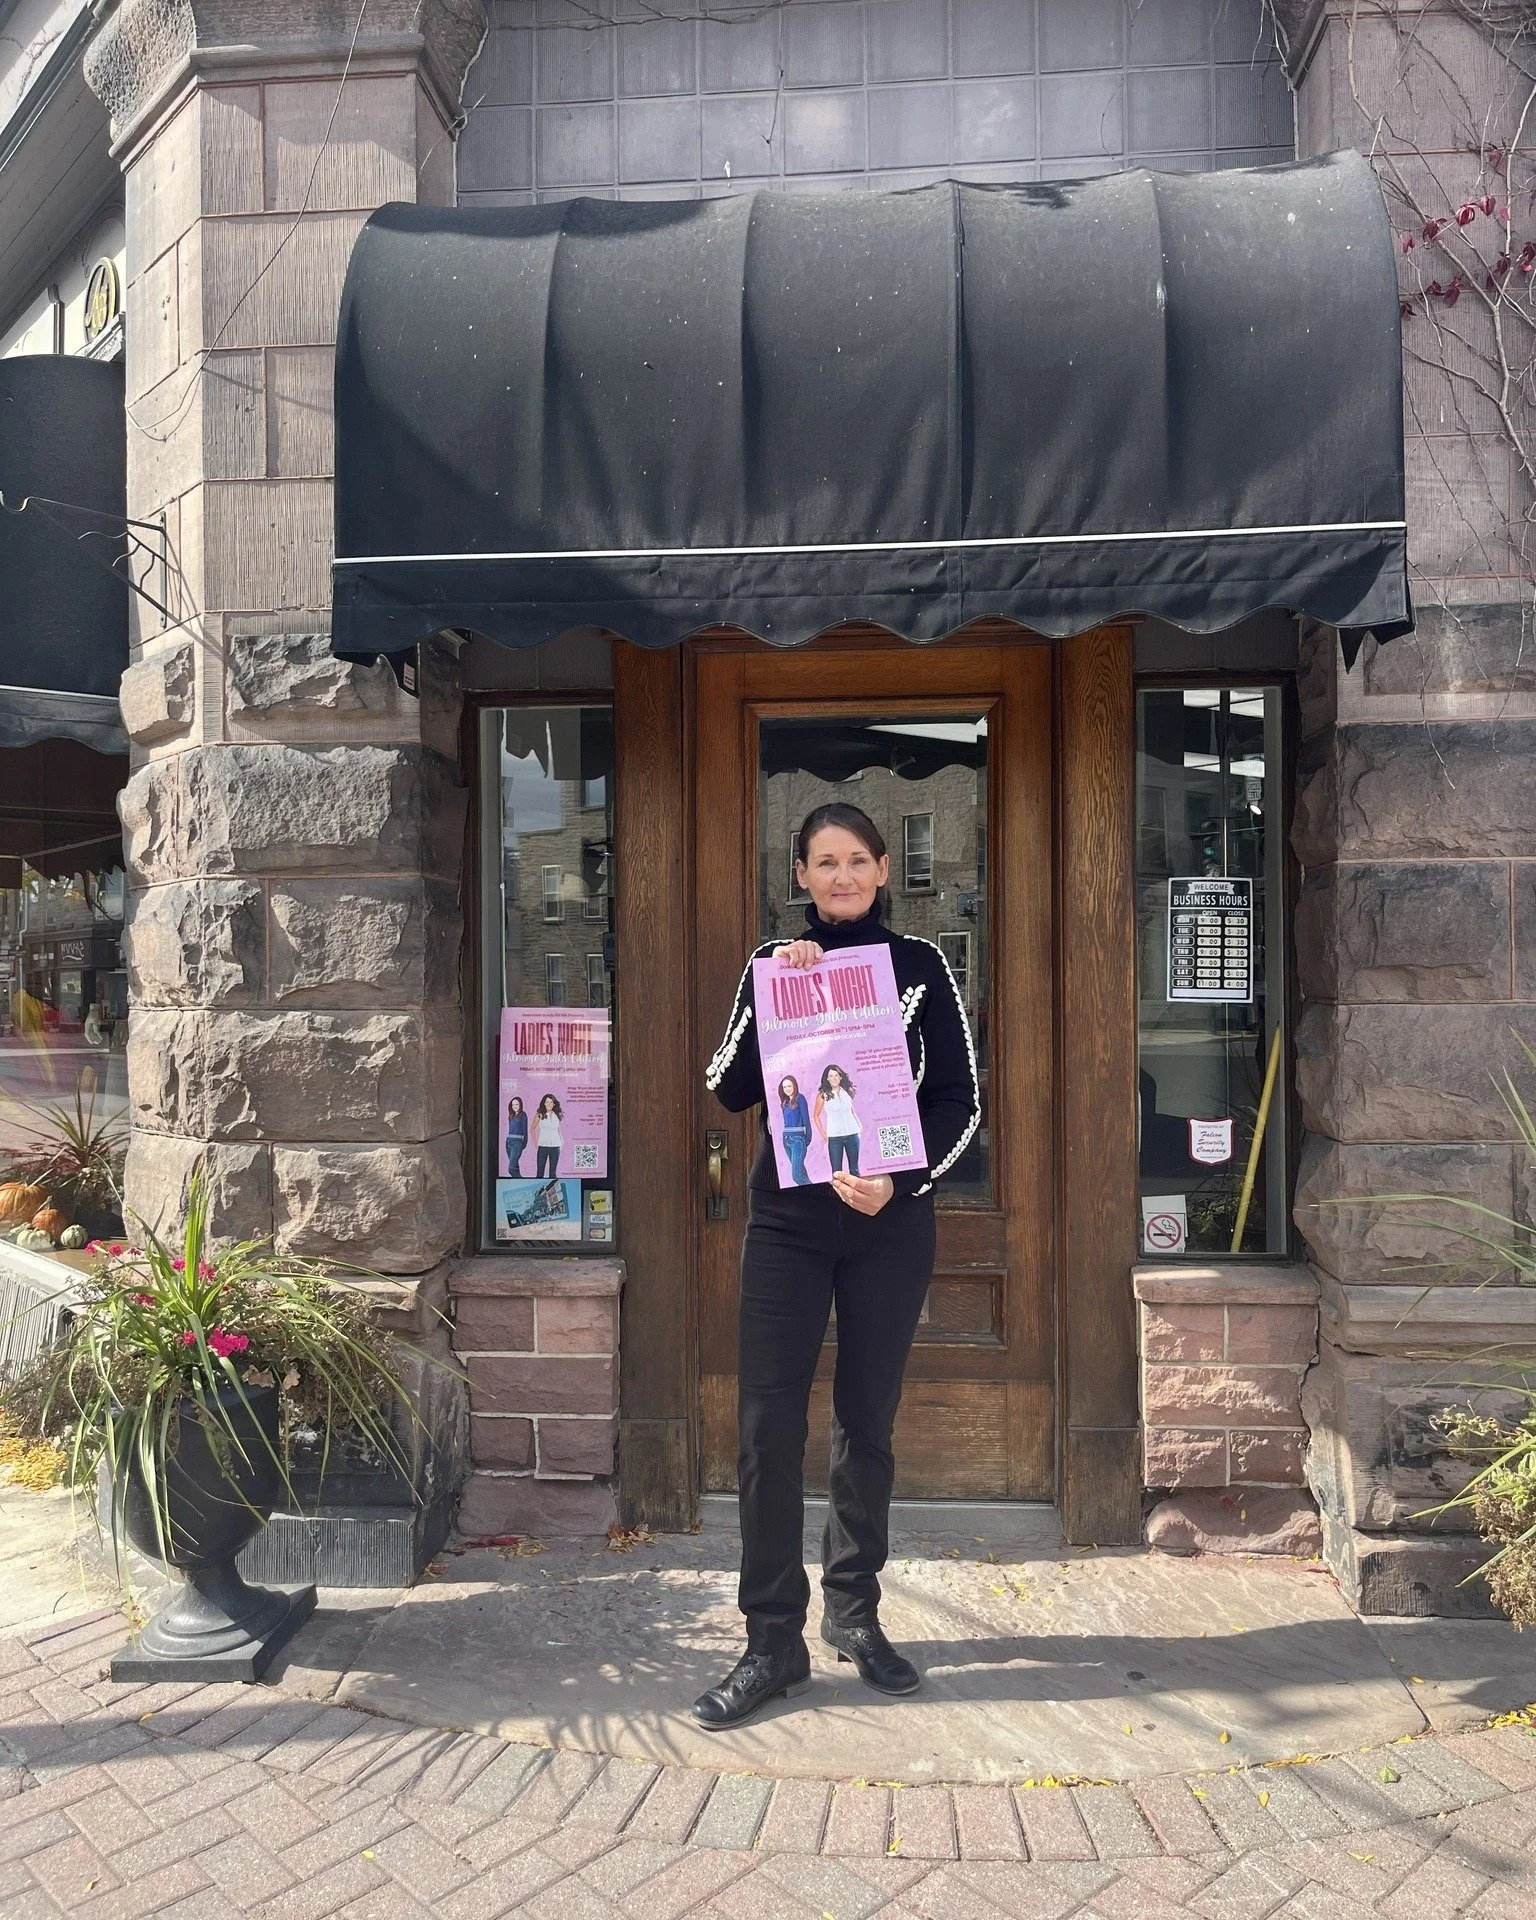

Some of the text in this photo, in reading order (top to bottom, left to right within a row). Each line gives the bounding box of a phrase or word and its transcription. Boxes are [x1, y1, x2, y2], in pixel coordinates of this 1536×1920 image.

[1173, 895, 1248, 906] BUSINESS HOURS
[771, 964, 878, 1022] LADIES NIGHT
[761, 1003, 896, 1034] Gilmore Girls Edition
[514, 1022, 593, 1056] LADIES NIGHT
[808, 1029, 835, 1038] OCTOBER
[503, 1051, 540, 1063] Gilmore
[544, 1051, 567, 1063] Girls
[1198, 1138, 1225, 1146] Security
